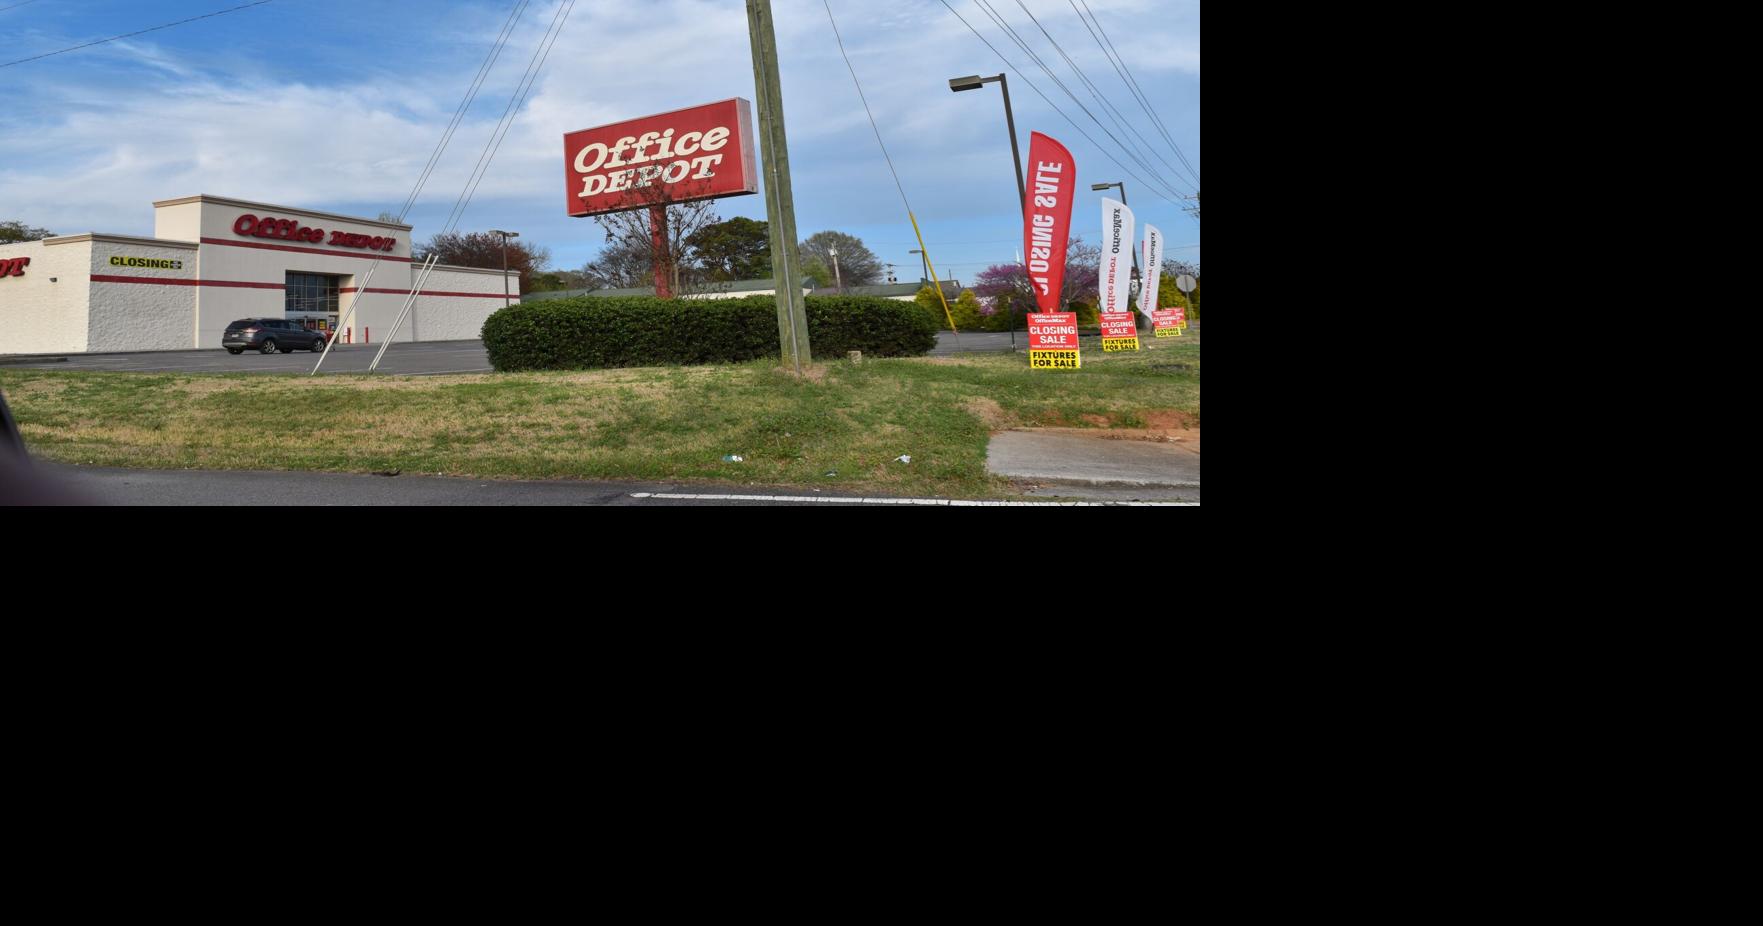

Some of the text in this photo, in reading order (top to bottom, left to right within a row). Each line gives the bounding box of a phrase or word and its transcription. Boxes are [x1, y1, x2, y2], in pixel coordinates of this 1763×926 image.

[574, 126, 730, 173] Office
[578, 154, 723, 197] DEPOT
[233, 214, 397, 251] Office DEPOT
[110, 256, 169, 269] CLOSING
[1030, 326, 1076, 335] CLOSING
[1040, 335, 1067, 344] SALE
[1033, 359, 1076, 367] FOR SALE
